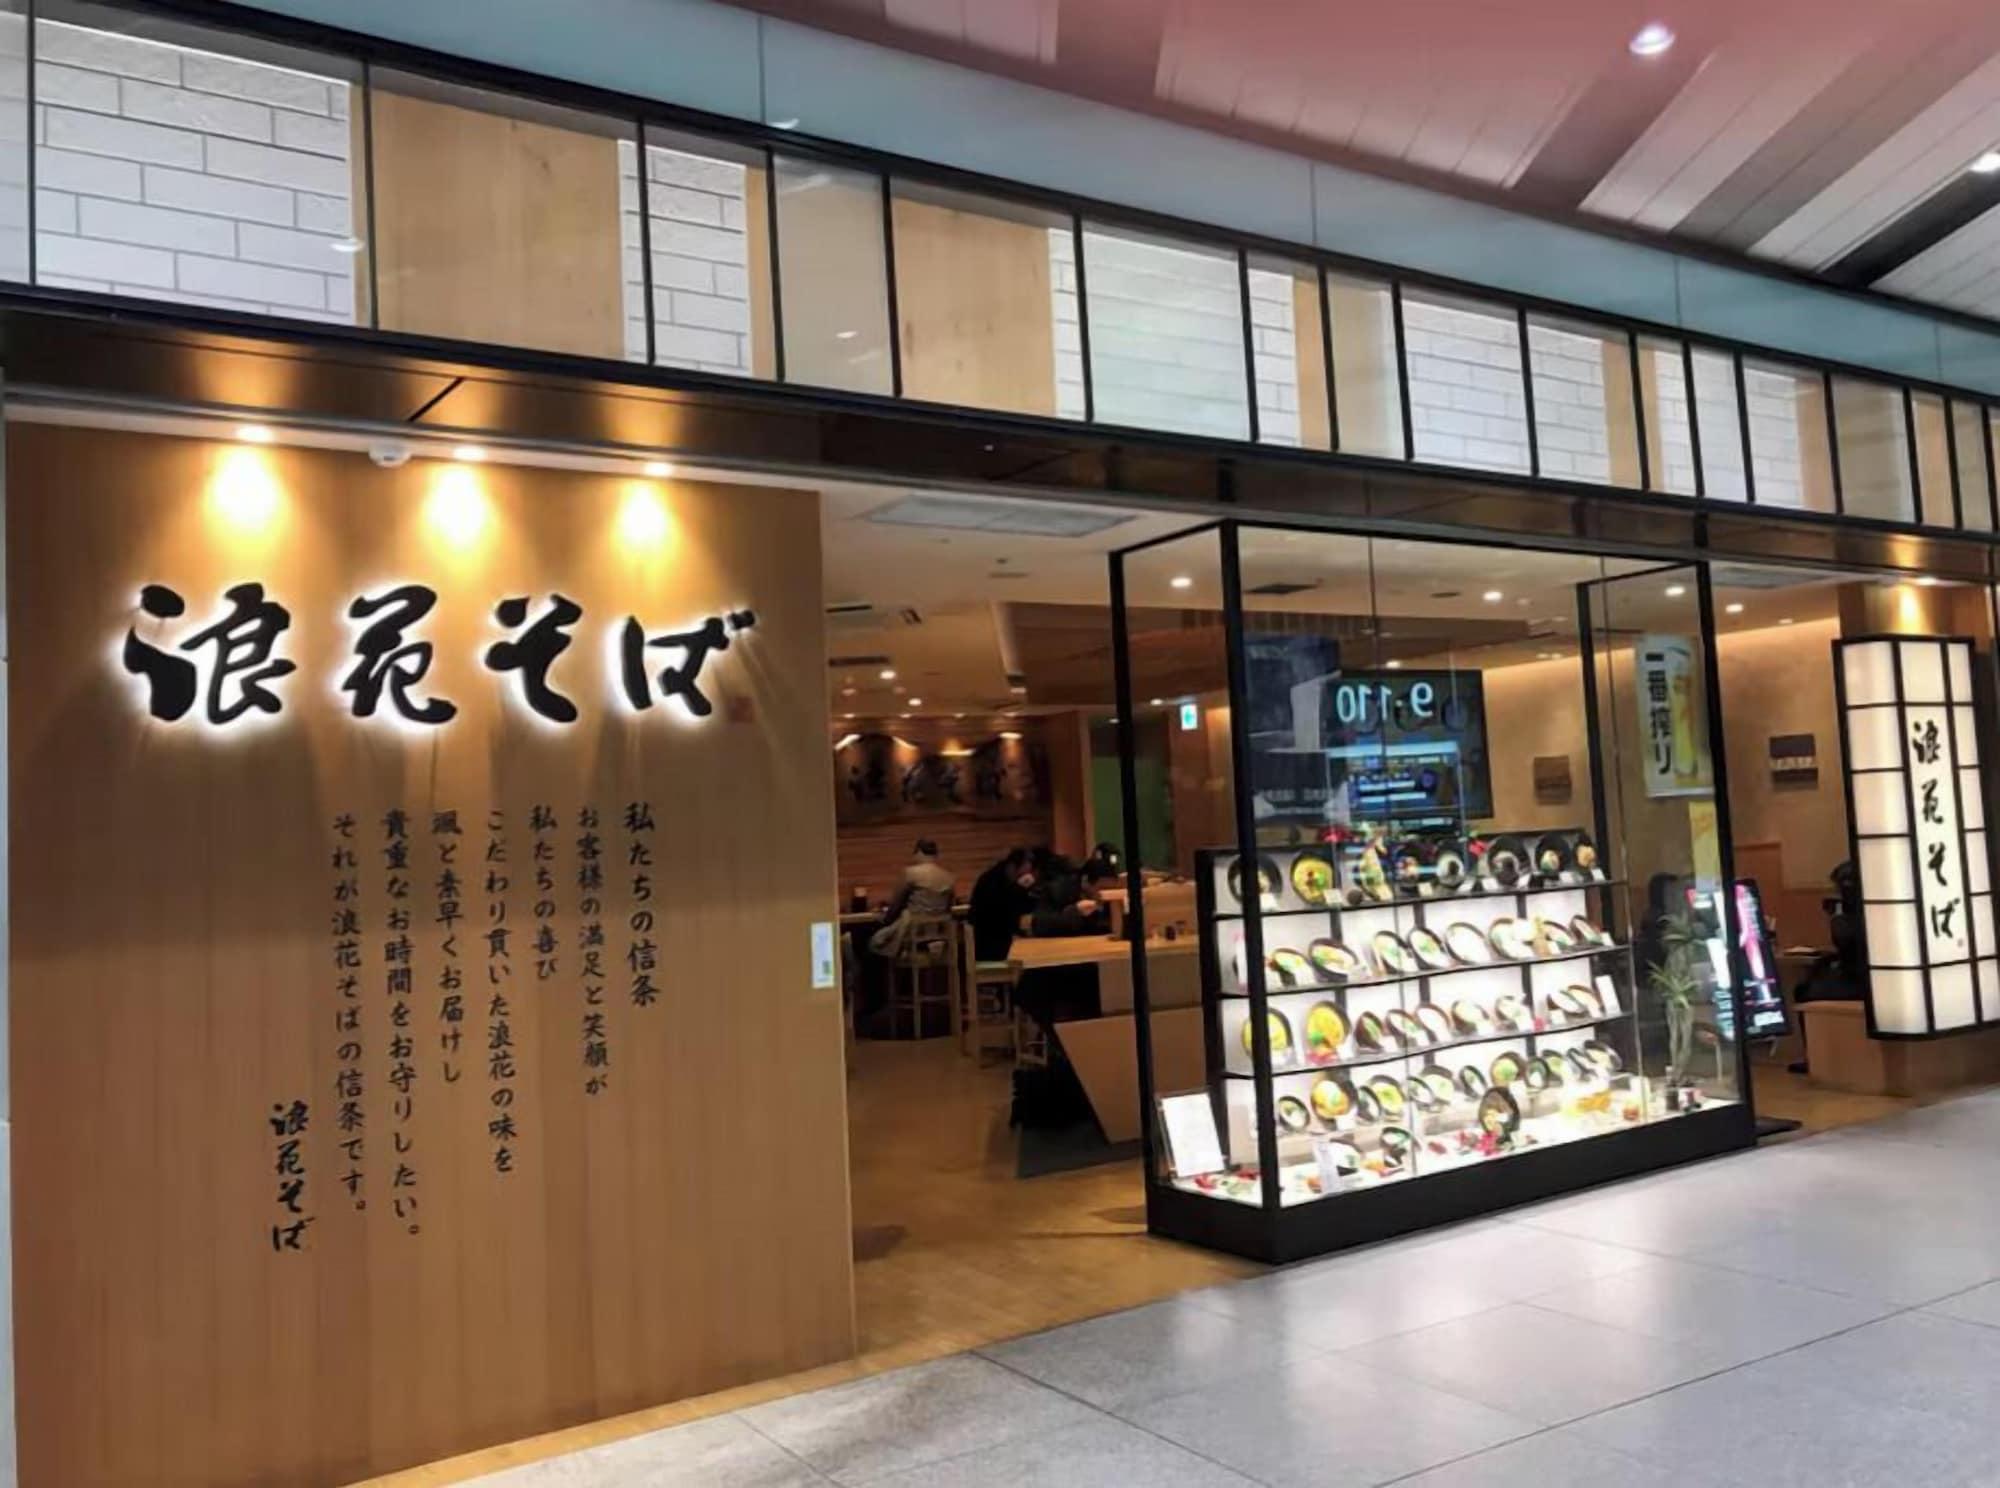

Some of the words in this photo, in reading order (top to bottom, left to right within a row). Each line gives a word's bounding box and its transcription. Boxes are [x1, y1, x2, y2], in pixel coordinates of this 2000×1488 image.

[124, 582, 756, 725] 浪花そば
[529, 804, 559, 982] 私たちの喜び
[623, 802, 661, 1007] 私たちの信条
[1912, 719, 1961, 938] 浪花そば
[332, 814, 367, 1210] それが浪花そばの信条です。
[382, 808, 421, 1235] 貴重なお時間をお守りしたい。
[482, 810, 518, 1173] こだわり貫いた浪花の味を
[575, 807, 609, 1097] お客様の満足と笑顔が
[270, 1100, 315, 1251] 浪花そば
